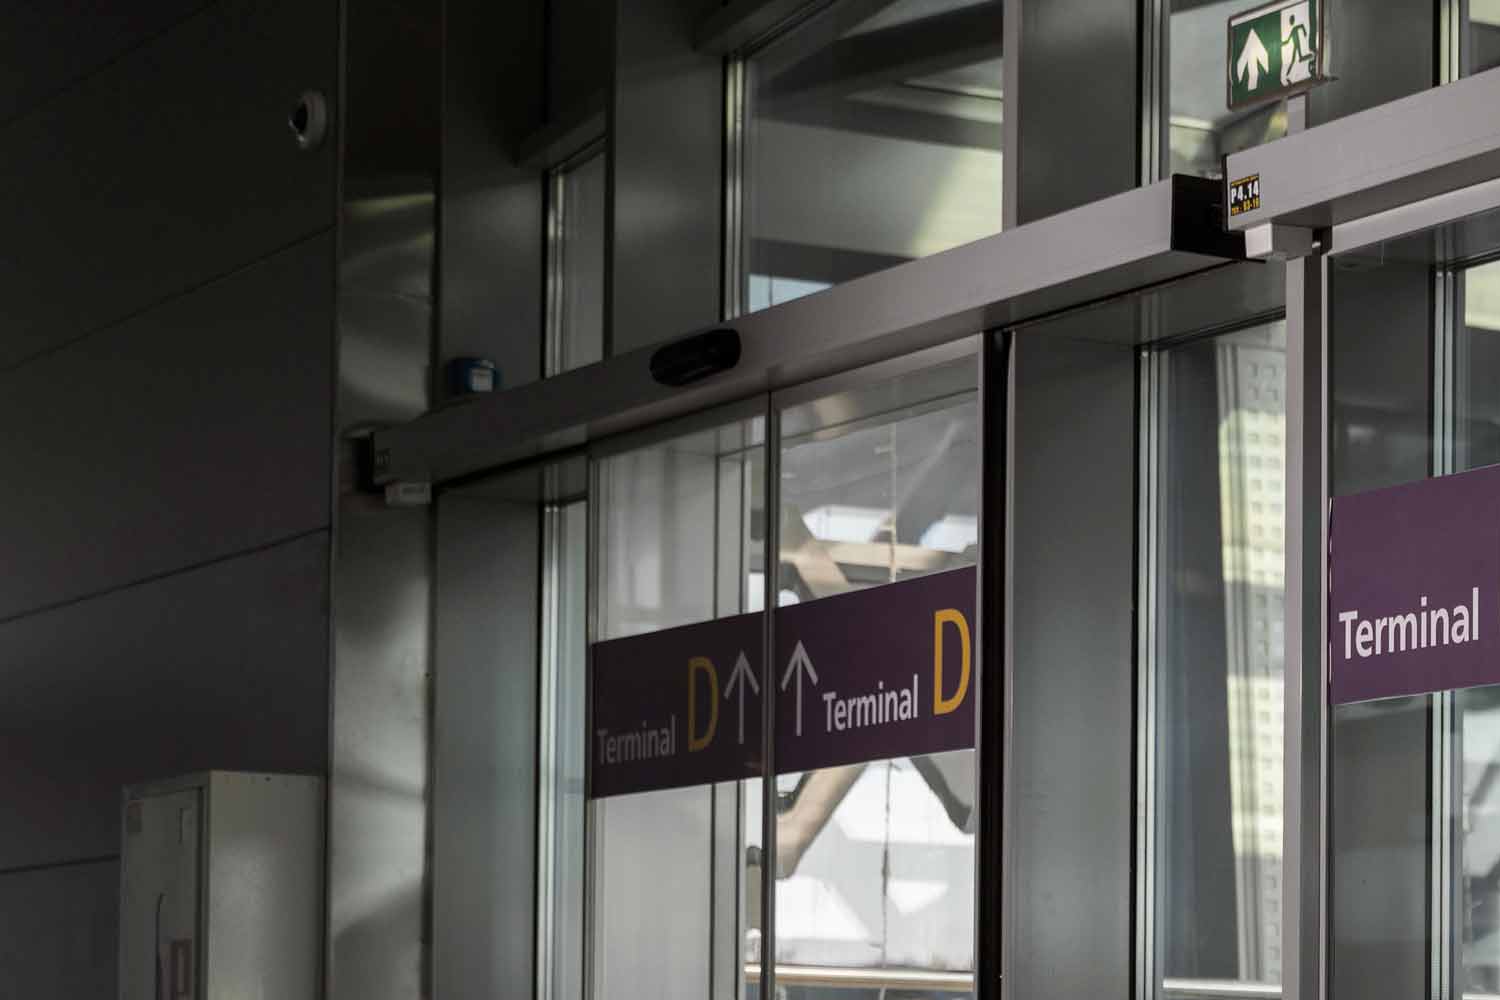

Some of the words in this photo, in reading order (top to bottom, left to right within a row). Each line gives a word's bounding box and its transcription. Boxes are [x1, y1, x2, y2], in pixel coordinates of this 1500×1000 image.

[822, 674, 919, 733] Terminal
[933, 607, 971, 716] D
[1338, 587, 1480, 660] Terminal
[597, 714, 676, 765] Terminal
[688, 656, 719, 752] D
